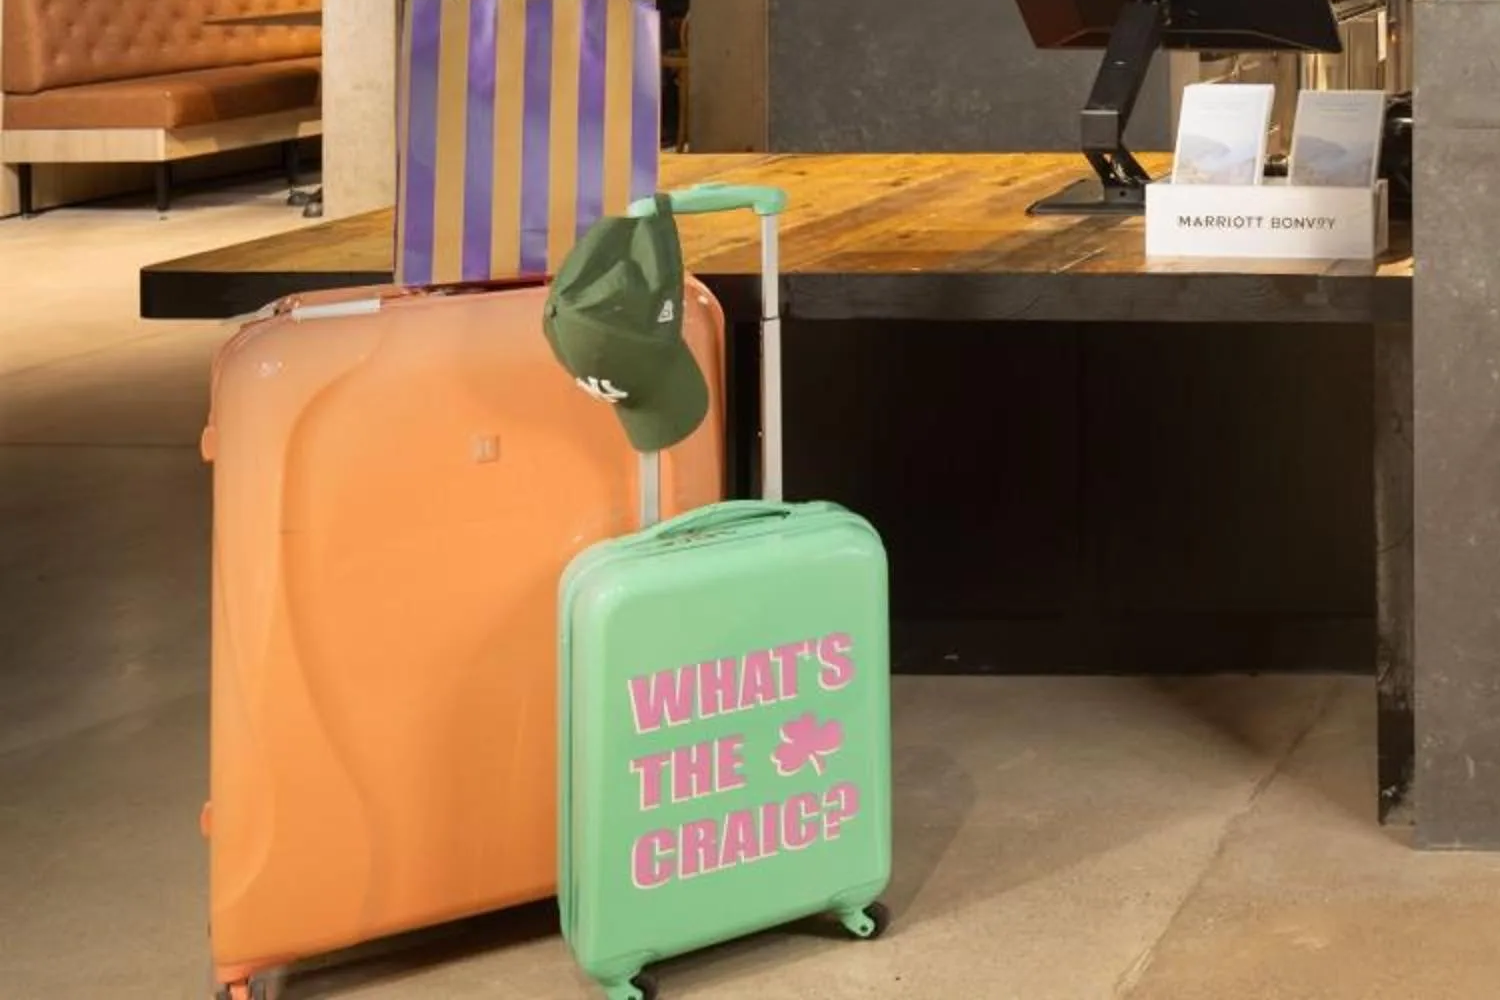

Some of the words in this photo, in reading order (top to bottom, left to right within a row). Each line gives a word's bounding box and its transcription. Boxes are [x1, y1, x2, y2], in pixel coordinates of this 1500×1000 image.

[1177, 214, 1264, 229] MARRIOTT
[1271, 216, 1337, 230] BONVOY
[628, 631, 855, 733] WHAT'S
[629, 732, 746, 811] THE
[631, 781, 860, 890] CRAIC?
